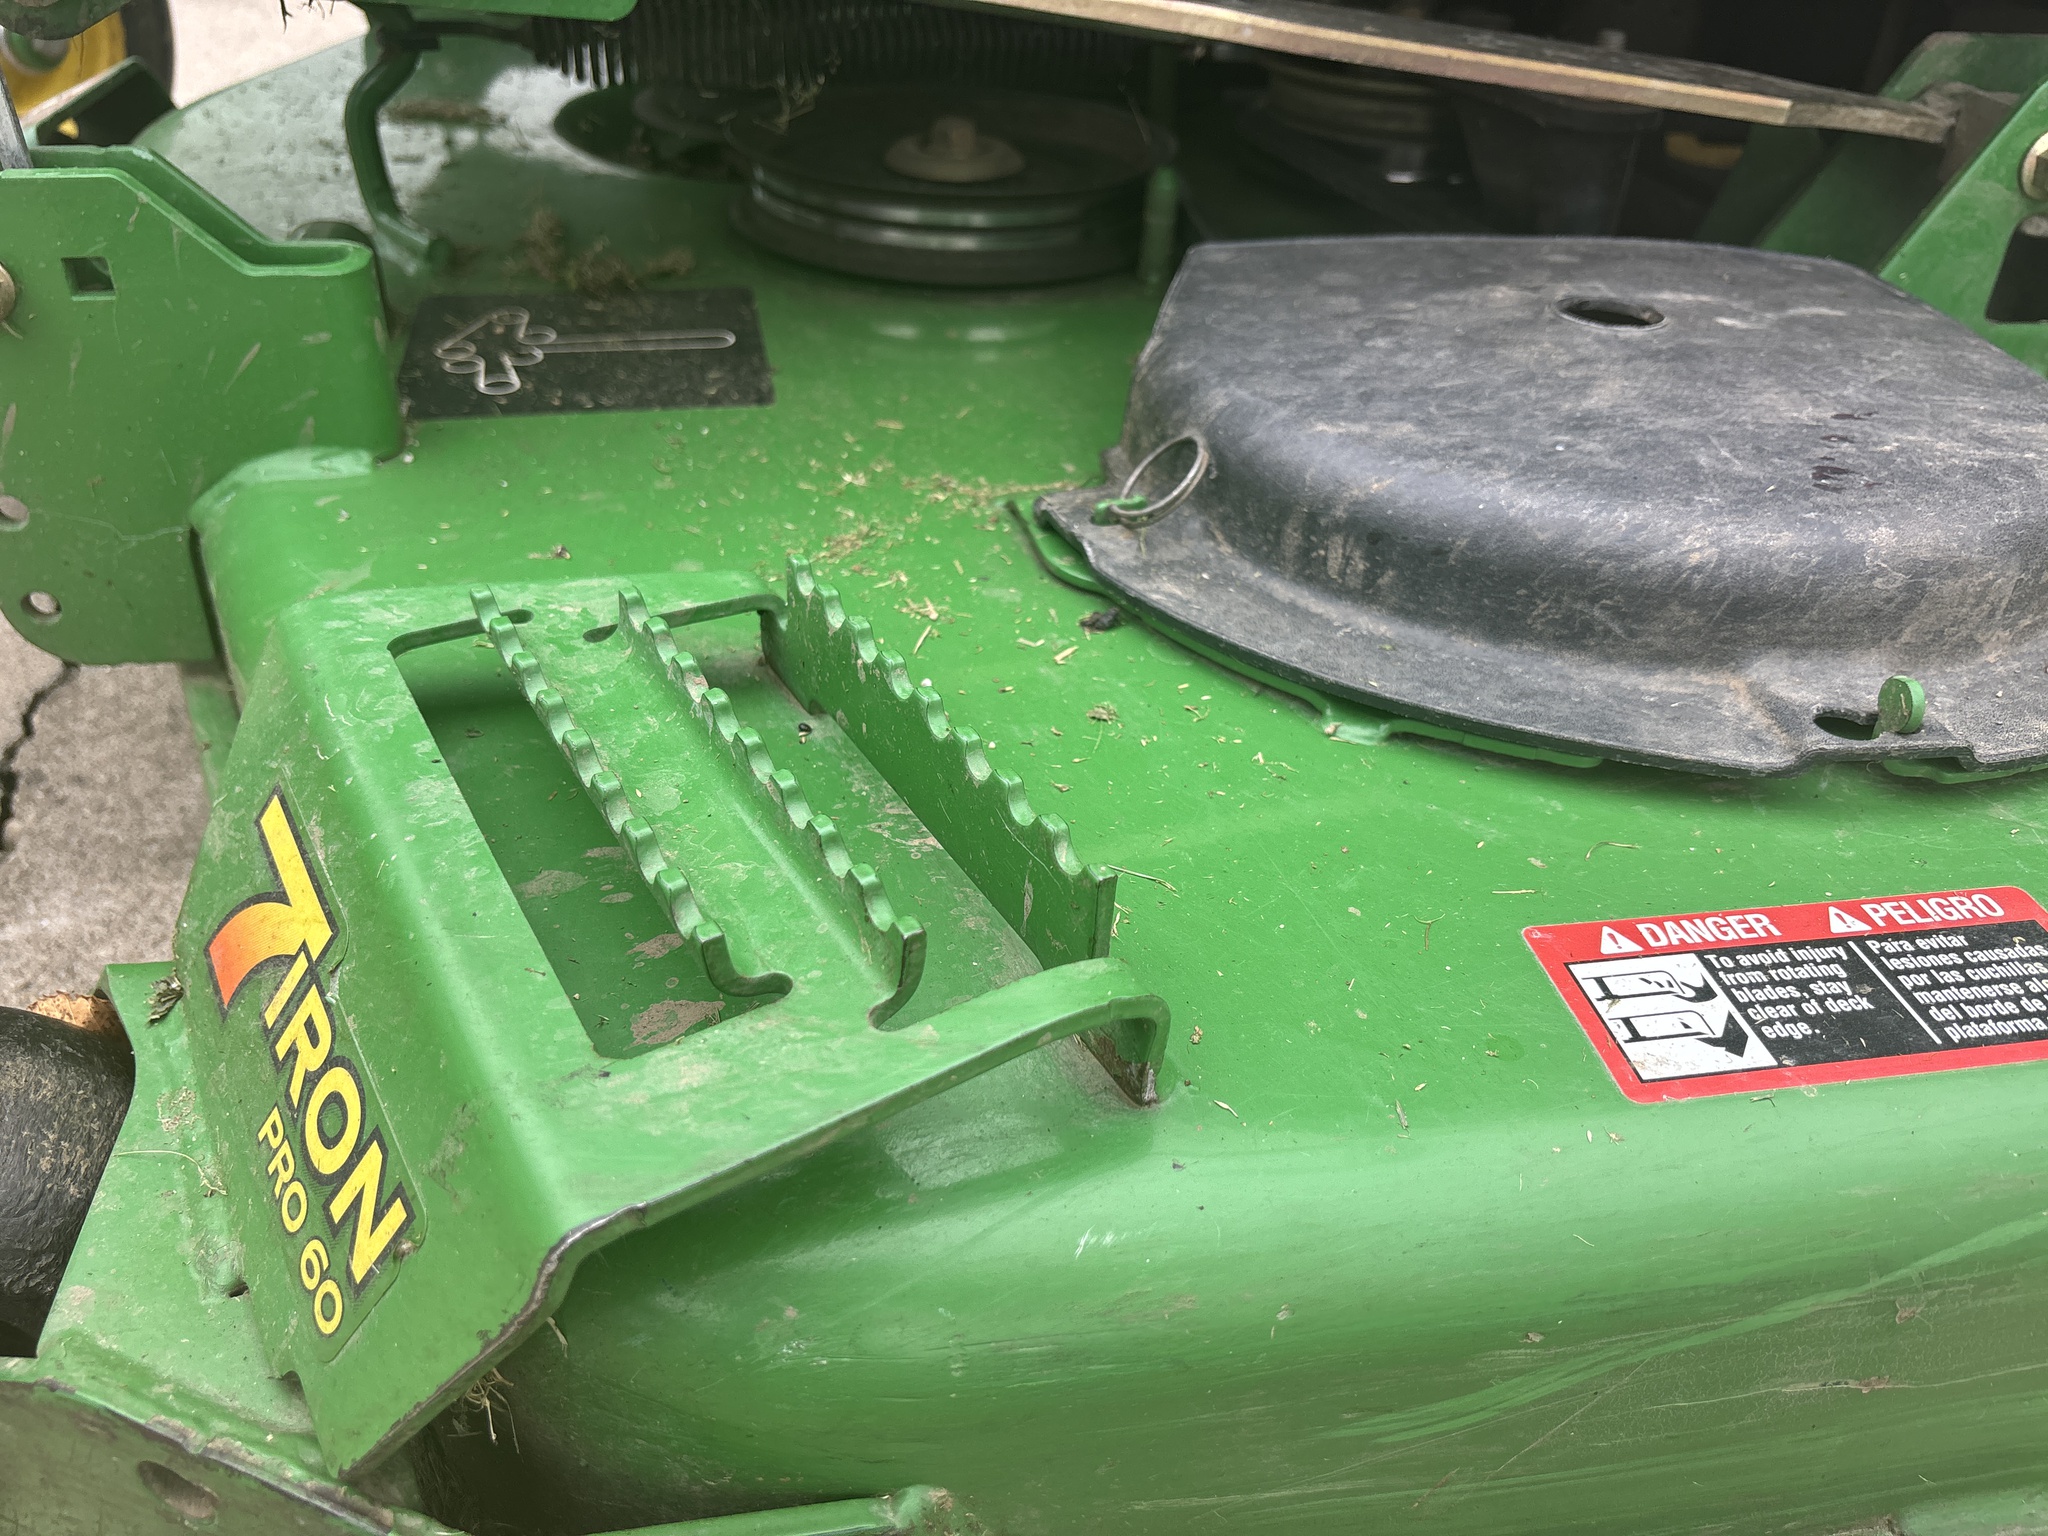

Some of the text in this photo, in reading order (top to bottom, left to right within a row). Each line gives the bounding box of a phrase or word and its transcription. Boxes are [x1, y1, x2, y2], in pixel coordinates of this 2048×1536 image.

[1860, 893, 2005, 927] PELIGRO
[1636, 913, 1782, 948] DANGER
[1865, 933, 1969, 954] Para evitar
[1704, 945, 1848, 969] To avoid injury
[1880, 943, 2048, 971] lesiones causadas
[1719, 962, 1847, 986] from rotating
[1897, 960, 2048, 990] por las cuchillas
[1731, 979, 1853, 1003] blades, stay
[1912, 981, 2025, 1004] mantenerse
[1747, 994, 1875, 1021] clear of deck
[1928, 996, 2047, 1022] del borde de
[1761, 1021, 1821, 1040] edge.
[1944, 1016, 2048, 1043] plataforma
[257, 1105, 344, 1336] PRO 60
